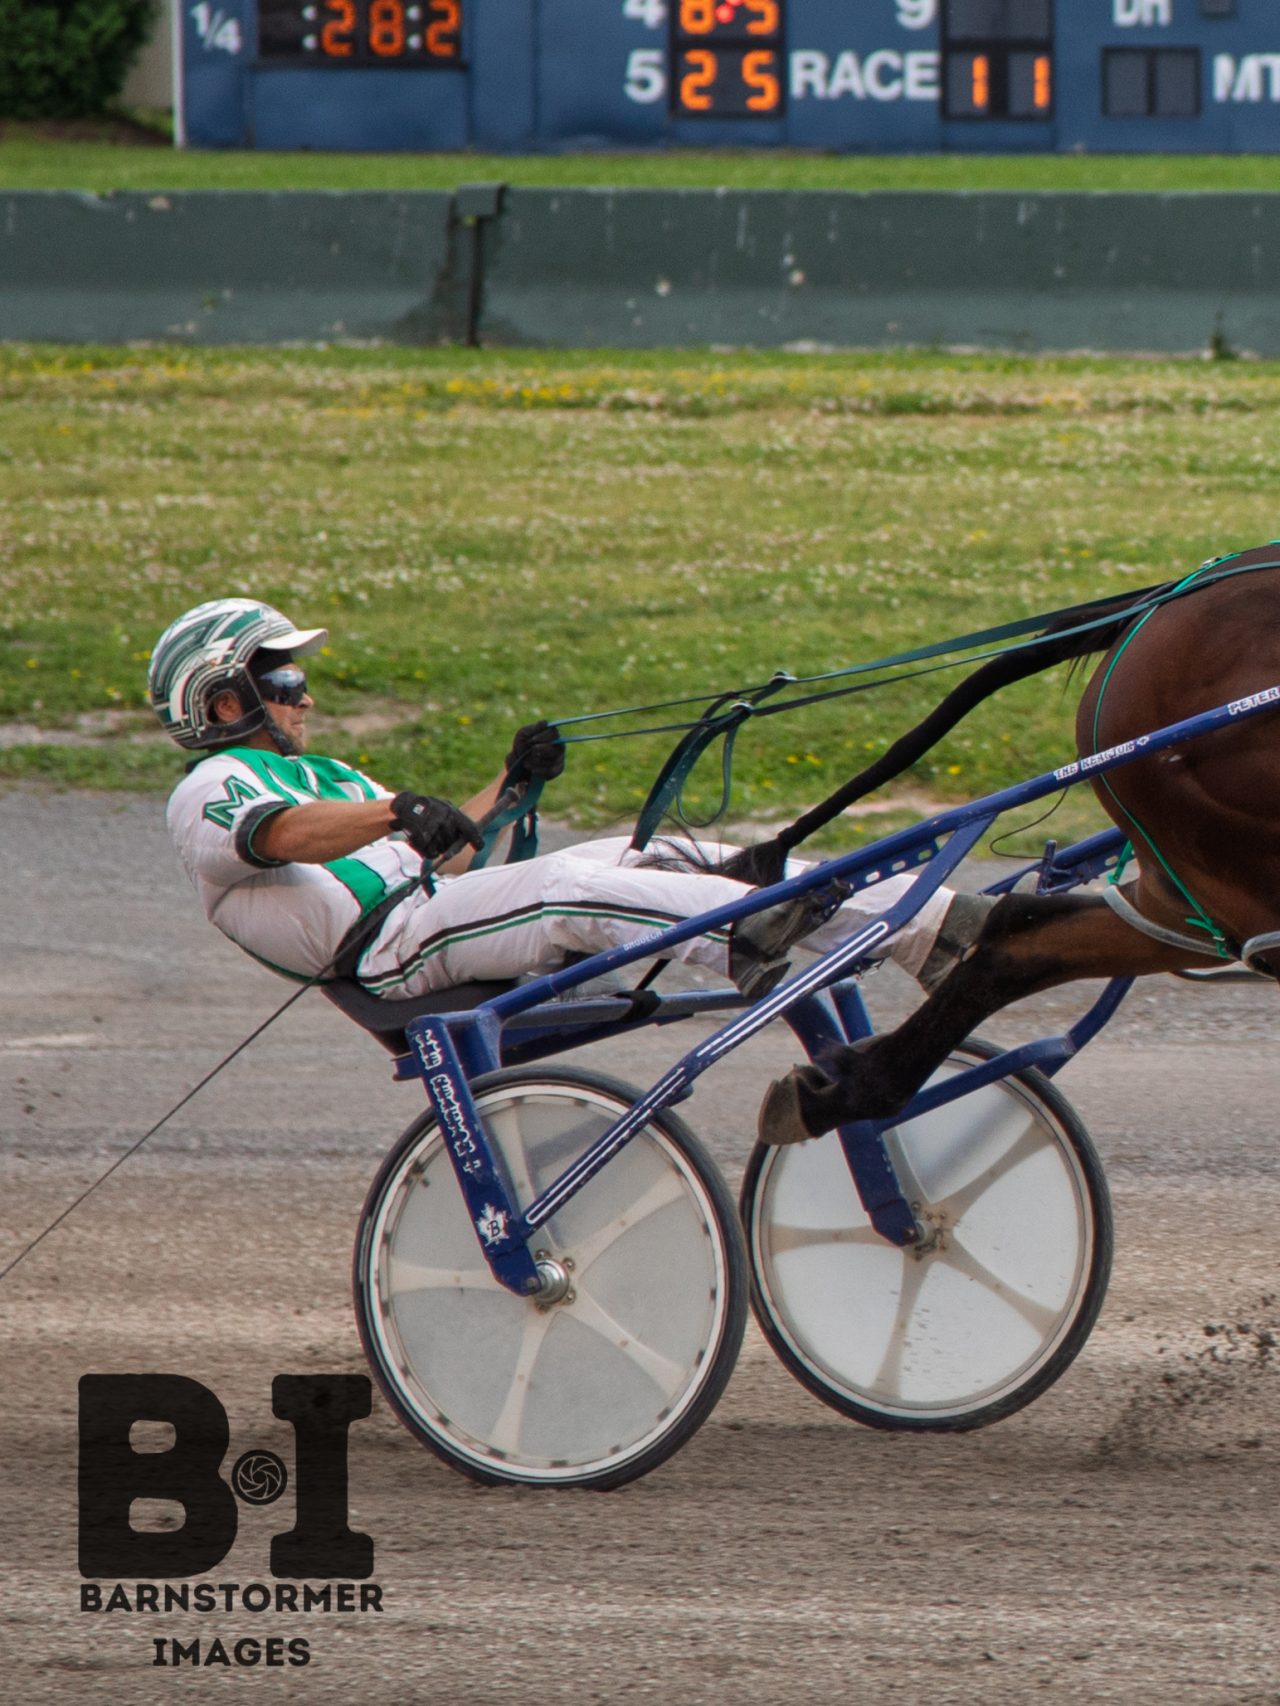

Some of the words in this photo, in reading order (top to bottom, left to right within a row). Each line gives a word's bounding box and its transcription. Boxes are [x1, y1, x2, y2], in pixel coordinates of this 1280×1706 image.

[624, 50, 666, 102] 5
[789, 51, 940, 99] RACE
[1229, 688, 1280, 715] PETER
[487, 1220, 501, 1237] B
